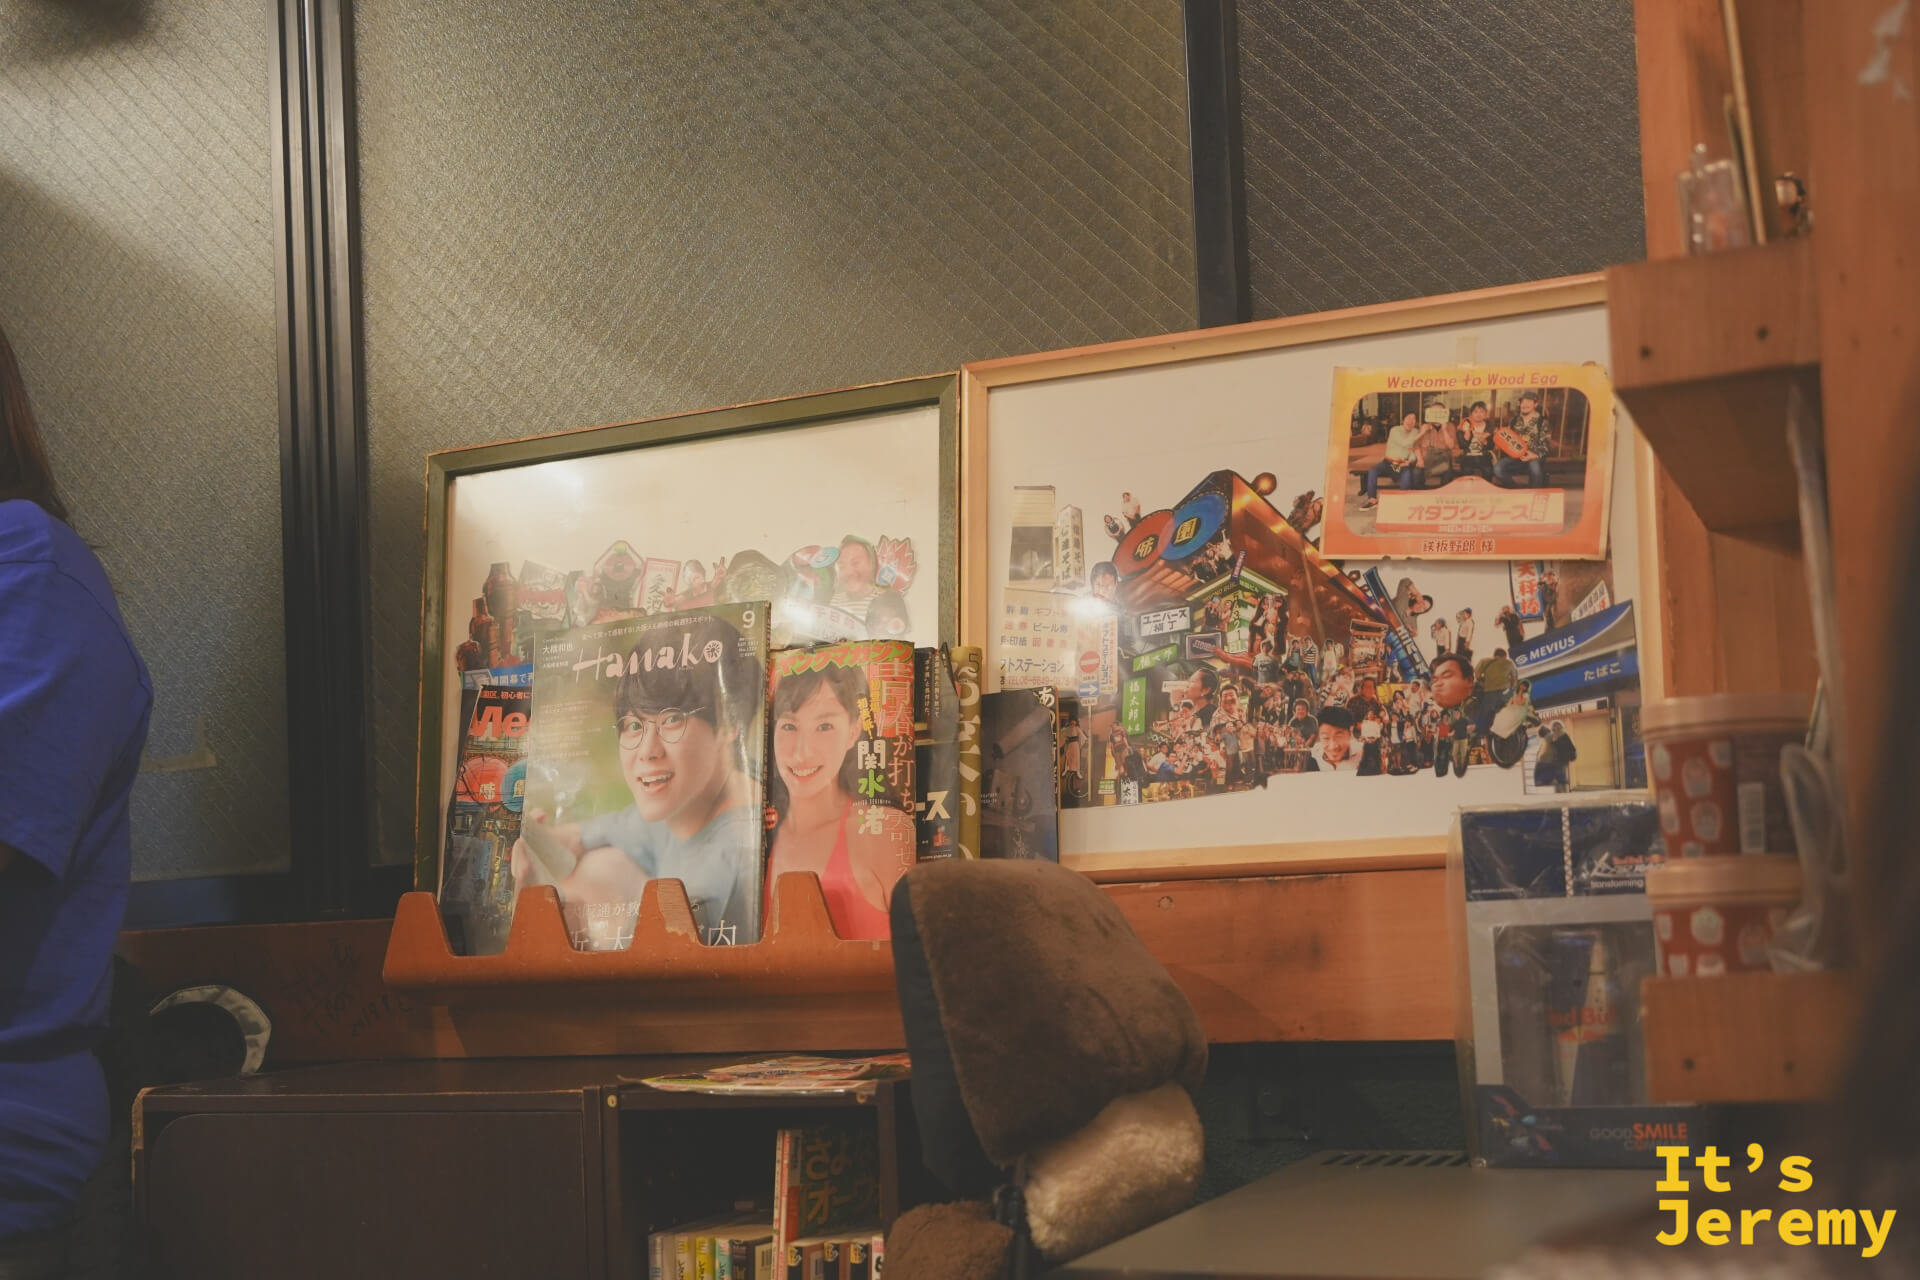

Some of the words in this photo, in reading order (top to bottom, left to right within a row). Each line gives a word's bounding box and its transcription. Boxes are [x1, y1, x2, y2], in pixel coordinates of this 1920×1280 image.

[1387, 375, 1457, 389] Welcome
[1463, 373, 1482, 387] to
[1487, 373, 1525, 386] Wood
[1530, 372, 1558, 386] Egg
[1407, 503, 1529, 522] オタフクソース
[1423, 539, 1476, 553] 鉄板野郎
[1480, 539, 1496, 552] 様
[742, 610, 756, 629] 9
[1142, 608, 1188, 625] ユニバース
[1233, 610, 1240, 621] 3
[1233, 620, 1240, 630] 2
[1529, 635, 1576, 661] MEVIUS
[572, 632, 724, 684] Hanako
[779, 641, 914, 676] ヤングマガジン
[1584, 661, 1622, 681] たばこ
[467, 705, 532, 738] Me
[857, 740, 886, 835] 関水渚
[1633, 1121, 1688, 1140] SMILE
